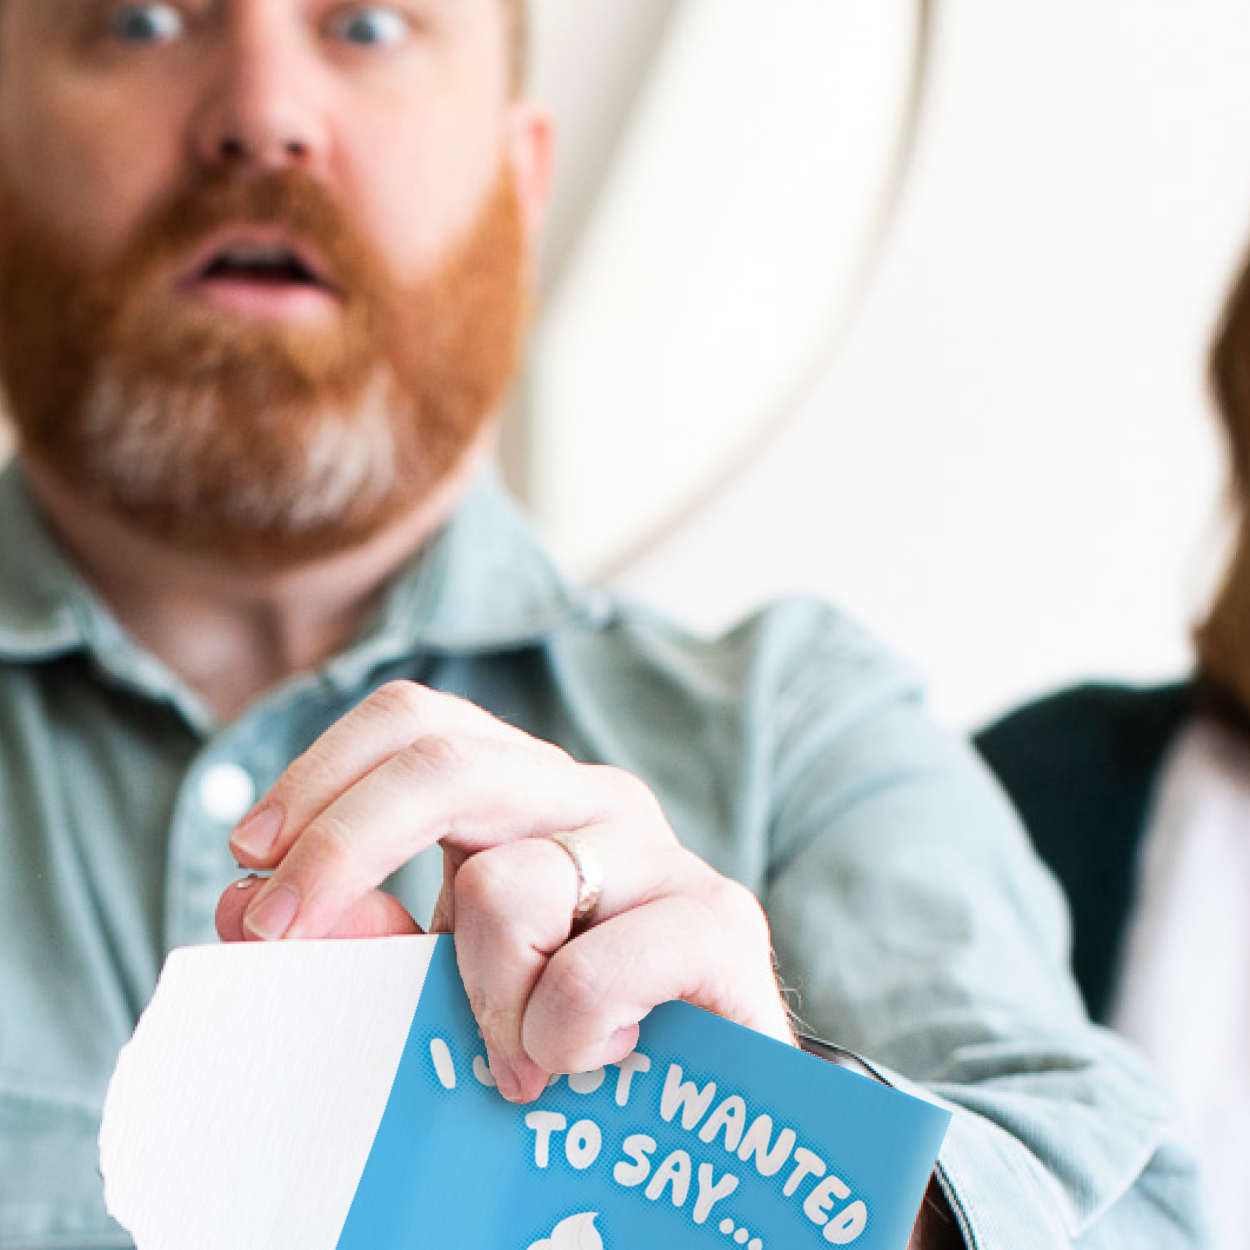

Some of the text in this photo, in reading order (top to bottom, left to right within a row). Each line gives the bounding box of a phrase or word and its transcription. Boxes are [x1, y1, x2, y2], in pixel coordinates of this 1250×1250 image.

[429, 1037, 456, 1089] I
[660, 1063, 868, 1245] WANTED
[524, 1110, 602, 1169] TO
